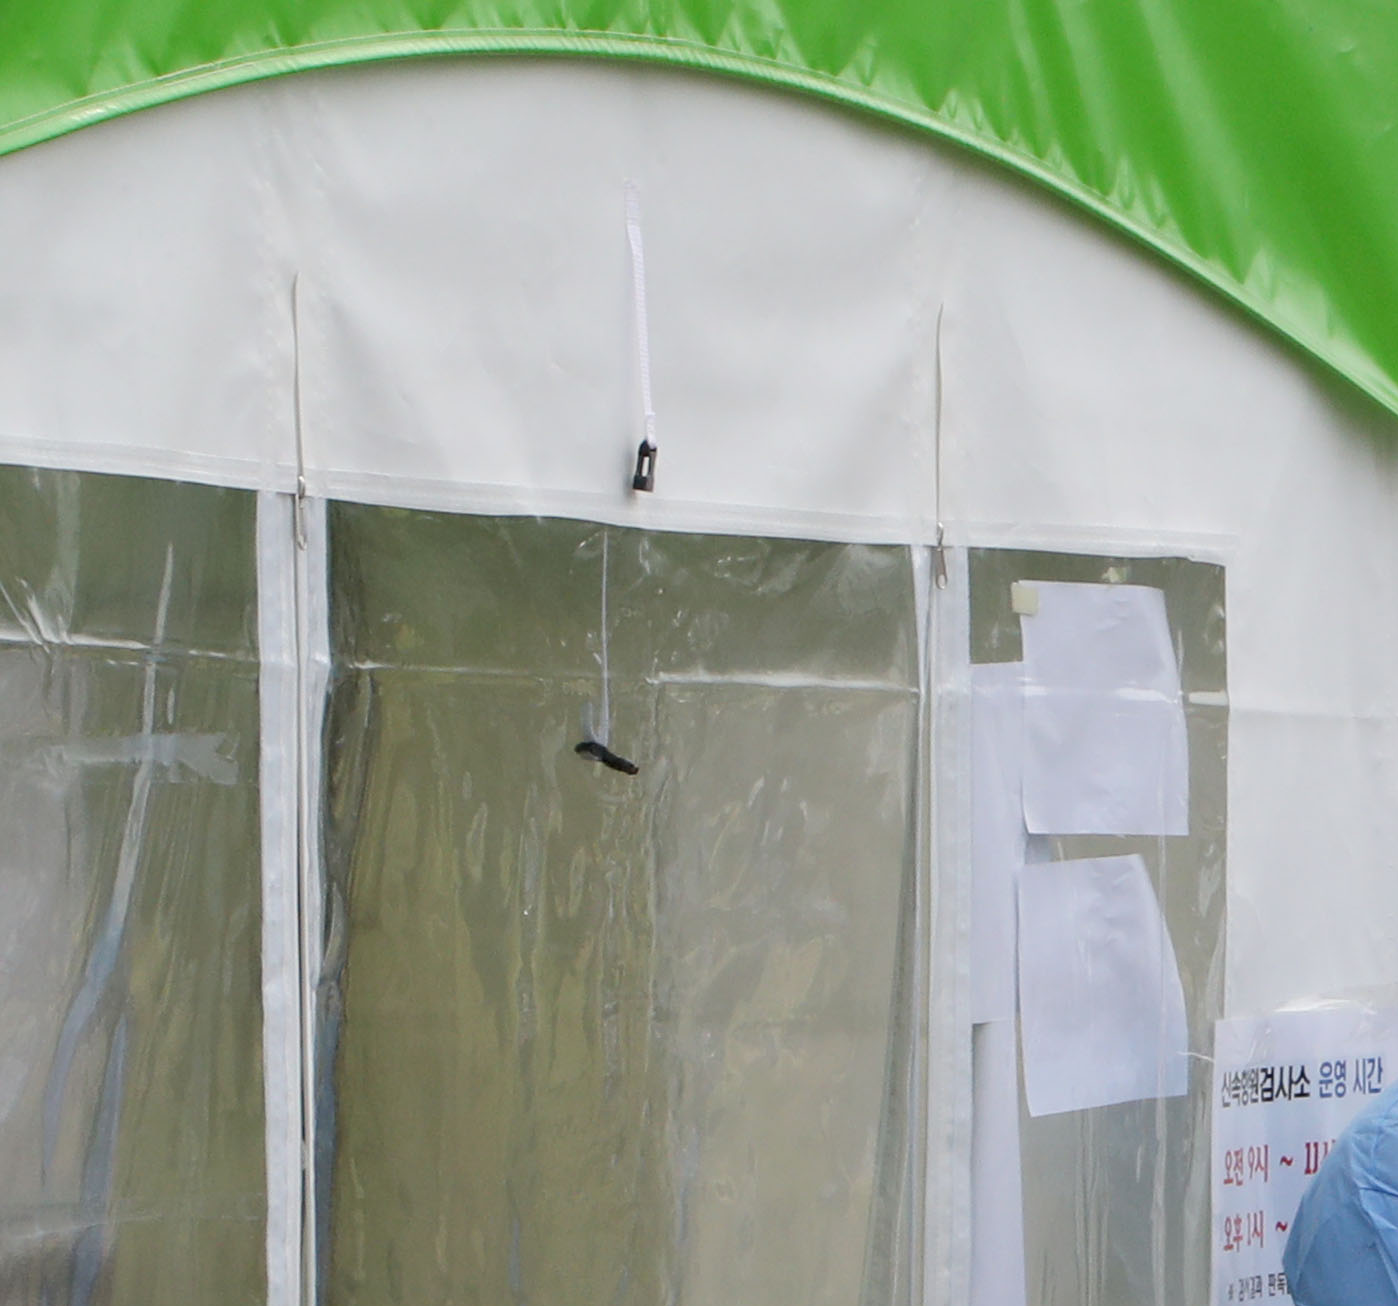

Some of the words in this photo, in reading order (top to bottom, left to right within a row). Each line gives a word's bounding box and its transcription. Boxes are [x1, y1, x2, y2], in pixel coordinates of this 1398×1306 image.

[1221, 1064, 1311, 1108] 신속항원검사소
[1319, 1060, 1347, 1099] 운영
[1353, 1055, 1383, 1095] 시간
[1268, 1272, 1291, 1297] 판독
